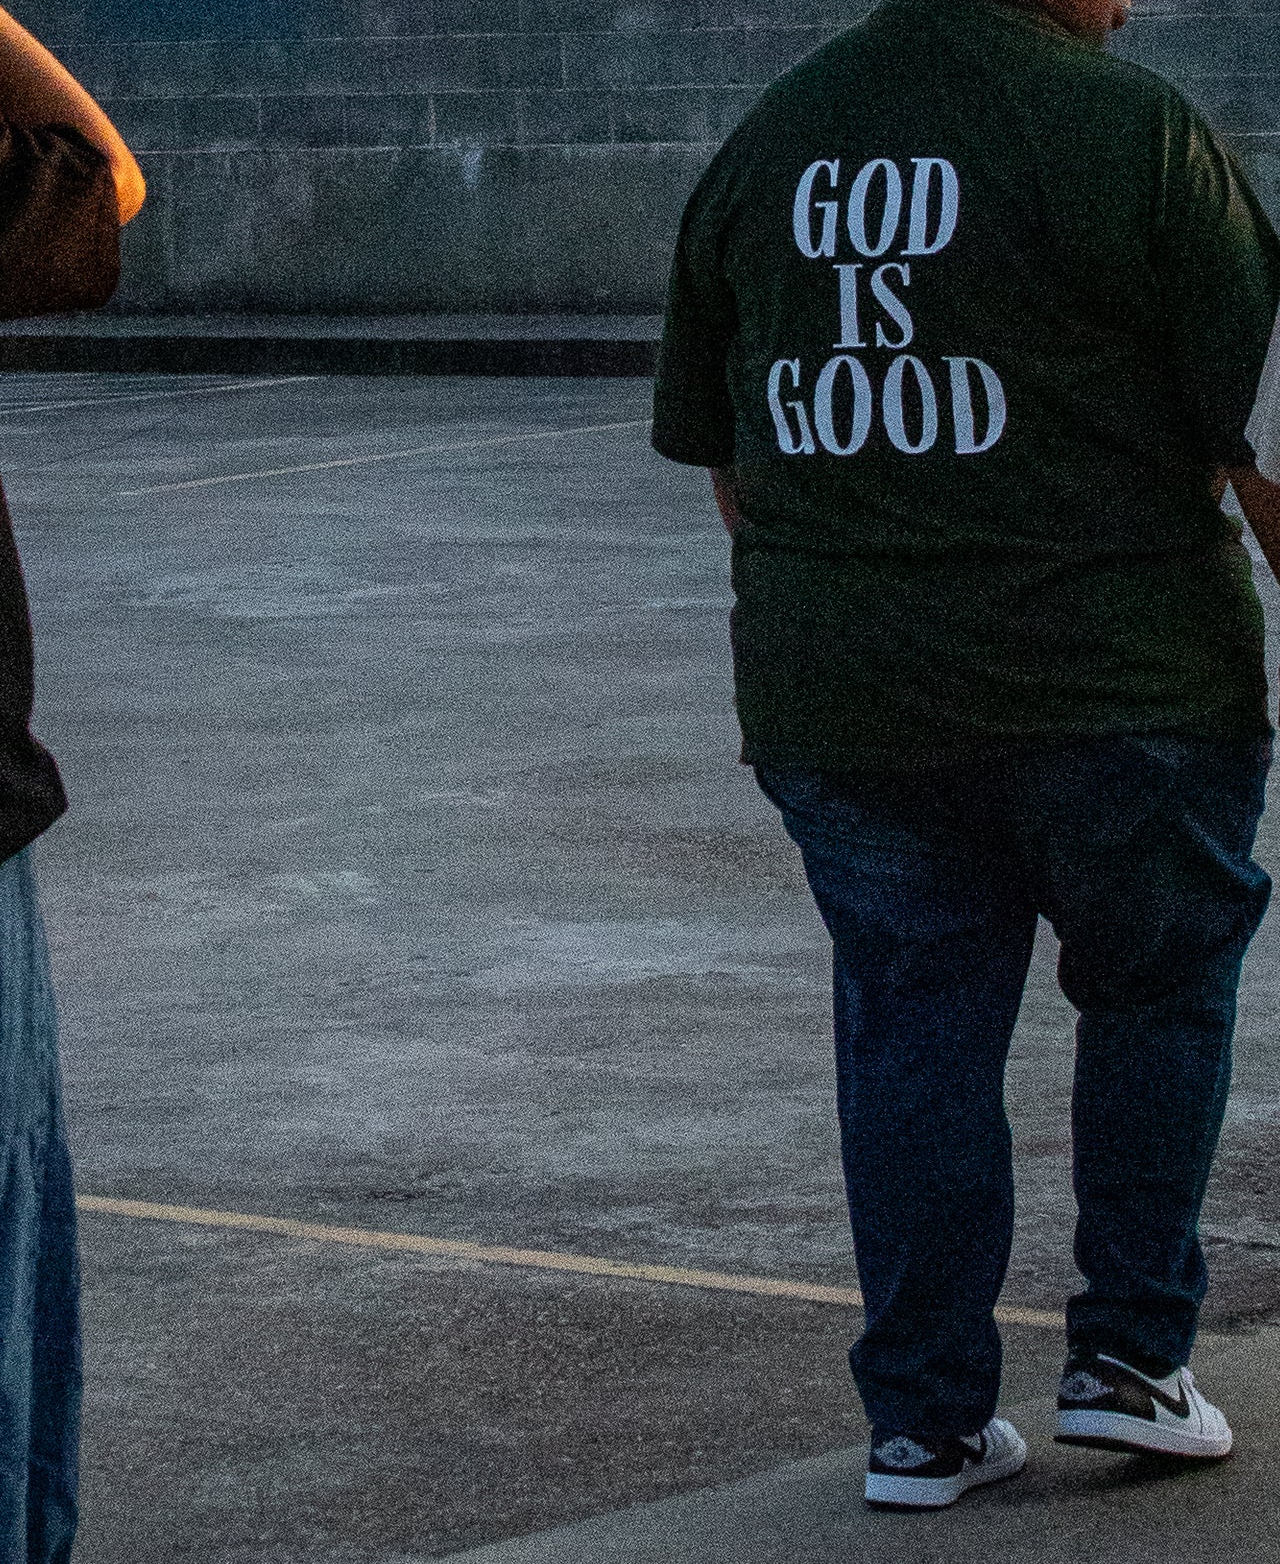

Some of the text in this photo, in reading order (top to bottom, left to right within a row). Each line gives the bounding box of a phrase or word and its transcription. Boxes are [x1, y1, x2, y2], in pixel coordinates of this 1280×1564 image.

[793, 157, 959, 258] GOD
[832, 262, 914, 349] IS
[767, 354, 1007, 455] GOOD
